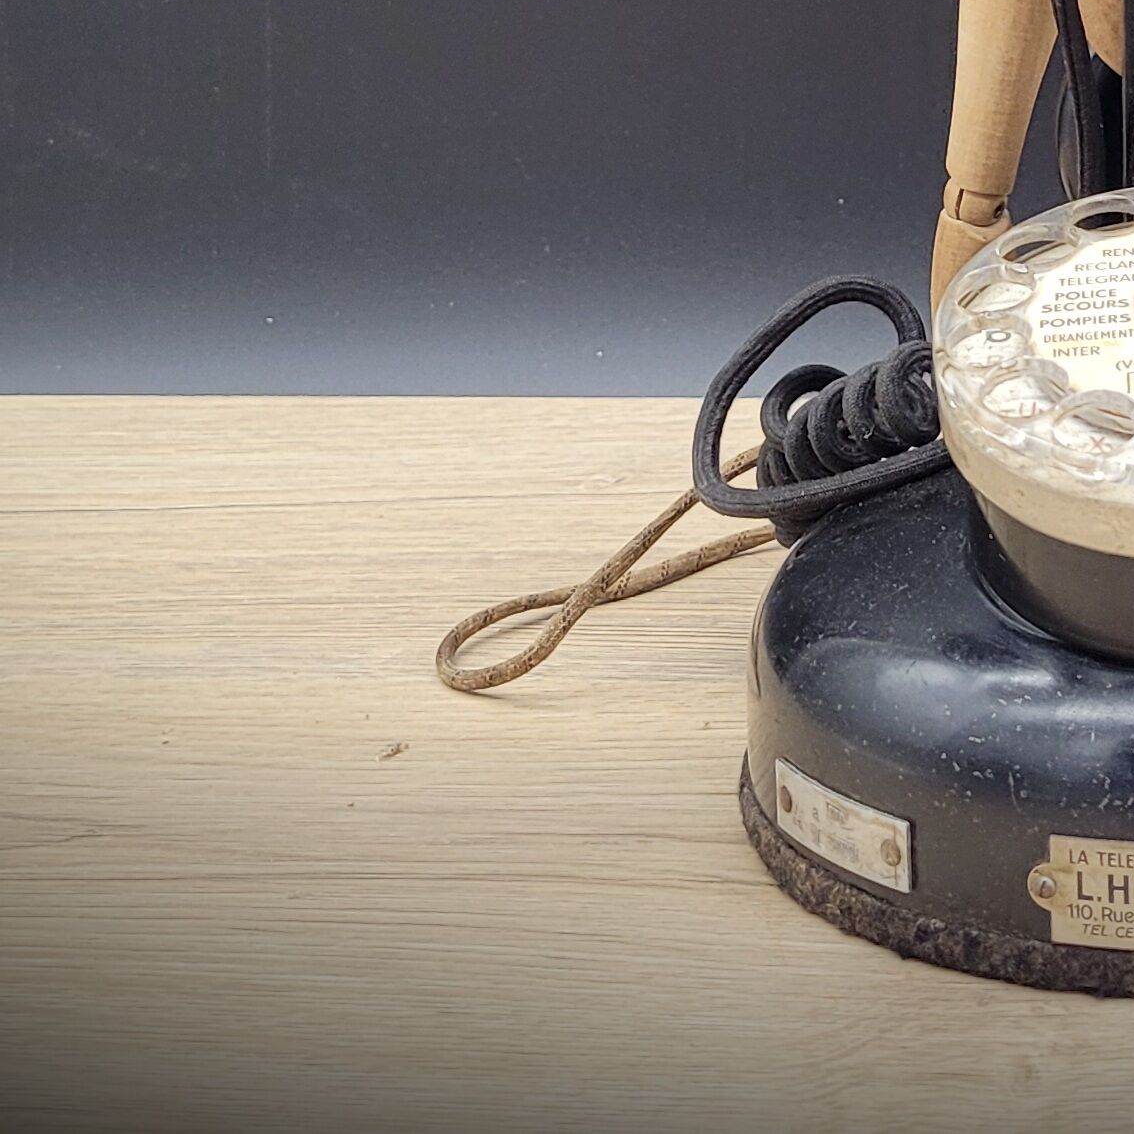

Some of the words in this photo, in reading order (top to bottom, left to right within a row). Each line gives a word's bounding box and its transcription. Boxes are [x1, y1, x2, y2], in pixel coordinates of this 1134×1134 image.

[1055, 289, 1118, 301] POLICE
[1041, 299, 1130, 314] SECOURS
[1039, 313, 1132, 329] POMPIERS
[1052, 346, 1101, 358] INTER
[1069, 849, 1088, 865] LA
[1101, 906, 1134, 924] Rue
[1082, 923, 1109, 937] TEL
